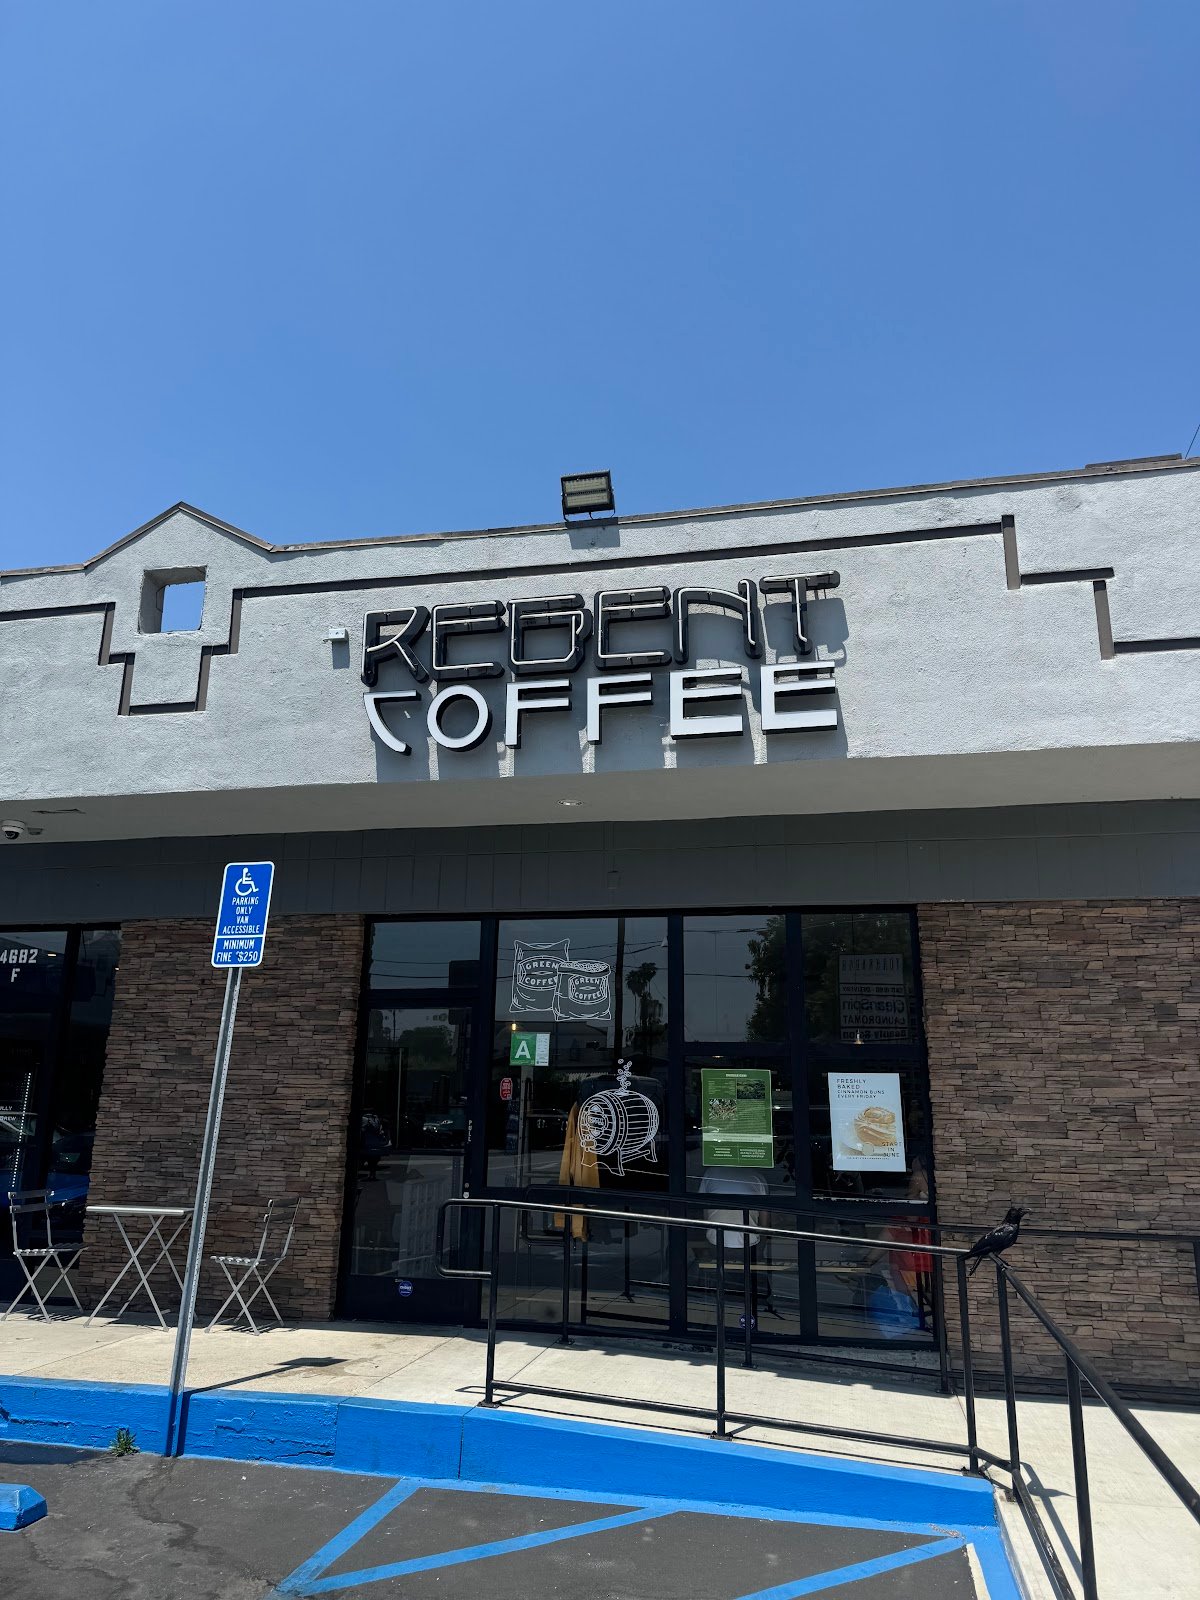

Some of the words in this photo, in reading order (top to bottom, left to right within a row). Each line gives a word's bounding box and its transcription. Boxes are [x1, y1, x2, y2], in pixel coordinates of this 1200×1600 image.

[363, 661, 838, 756] COFFEE
[231, 897, 259, 905] PARKING
[236, 906, 252, 914] ONLY
[236, 916, 249, 924] VAN
[222, 925, 260, 934] ACCESSIBLE
[223, 940, 255, 949] MINIMUM
[0, 949, 38, 964] 4682
[216, 951, 233, 962] FINE
[237, 951, 259, 963] $250
[525, 960, 559, 970] GREEN
[10, 967, 20, 983] F
[574, 977, 600, 985] GREEN
[574, 991, 602, 1000] COFFEE
[514, 1039, 531, 1059] A
